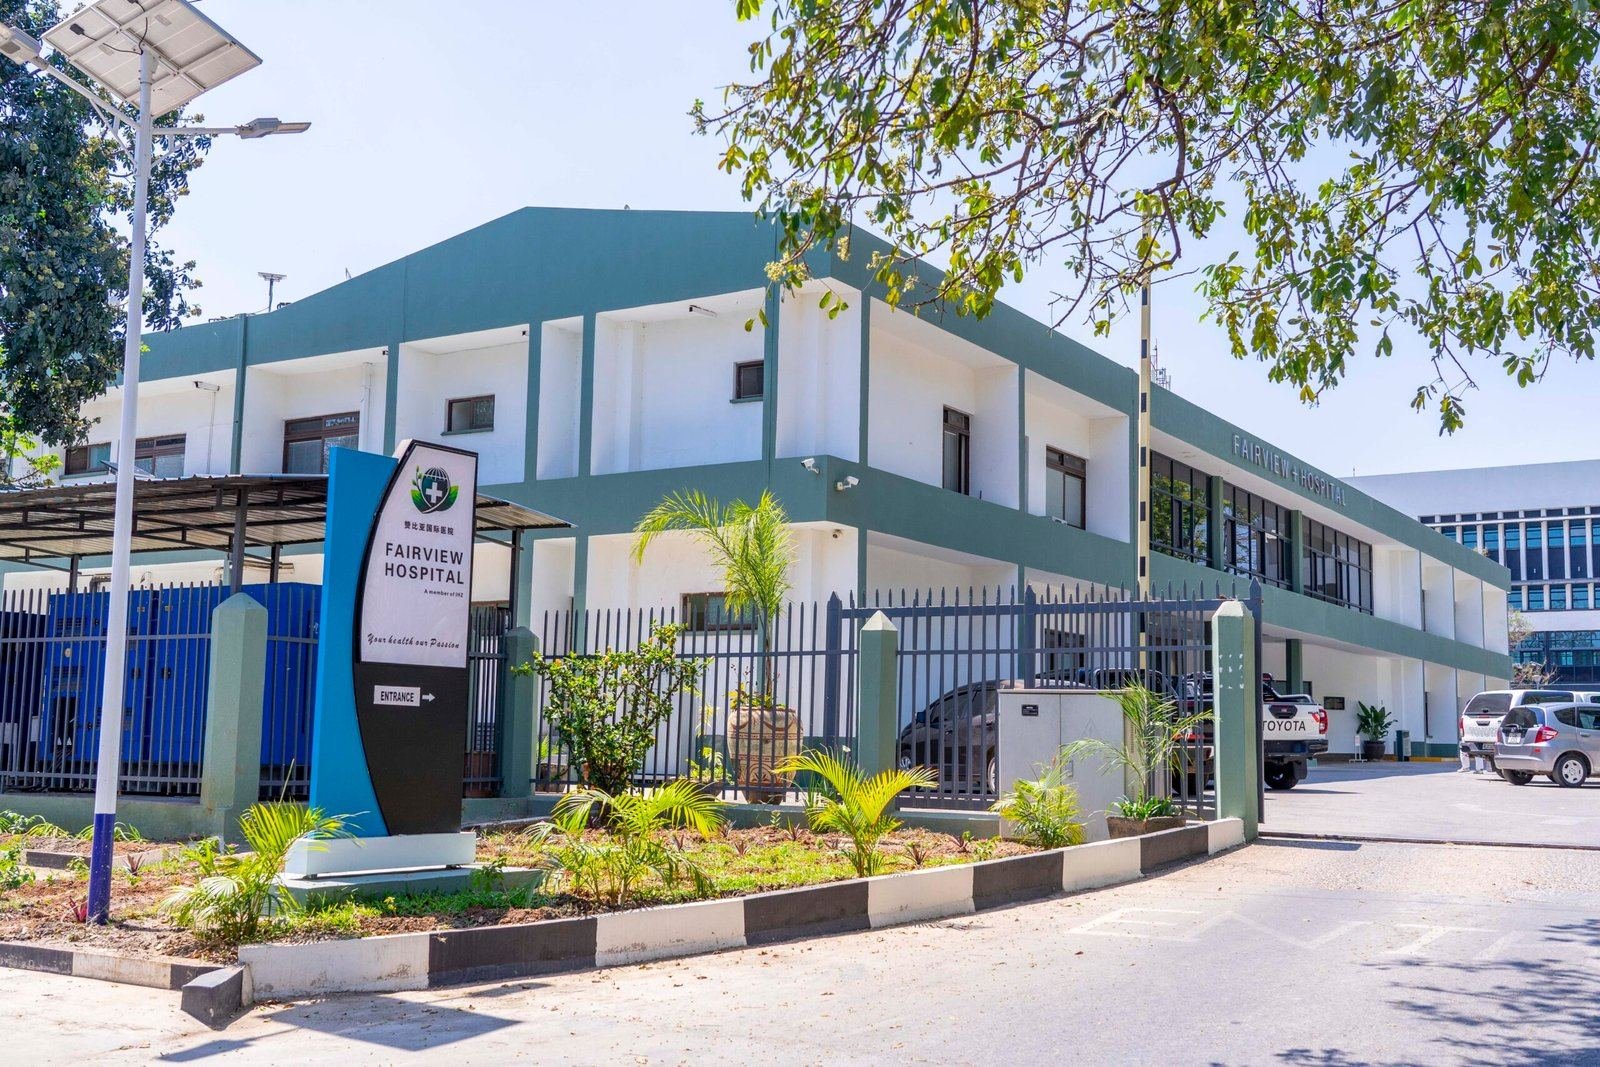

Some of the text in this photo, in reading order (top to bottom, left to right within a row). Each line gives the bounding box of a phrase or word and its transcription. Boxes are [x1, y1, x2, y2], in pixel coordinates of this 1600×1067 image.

[1233, 435, 1346, 506] FAIRVIEW HOSPITAL
[386, 542, 463, 565] FAIRVIEW
[385, 562, 464, 585] HOSPITAL
[367, 633, 386, 645] Your
[388, 635, 414, 645] health
[430, 638, 460, 648] Passion
[380, 691, 414, 702] ENTRANCE
